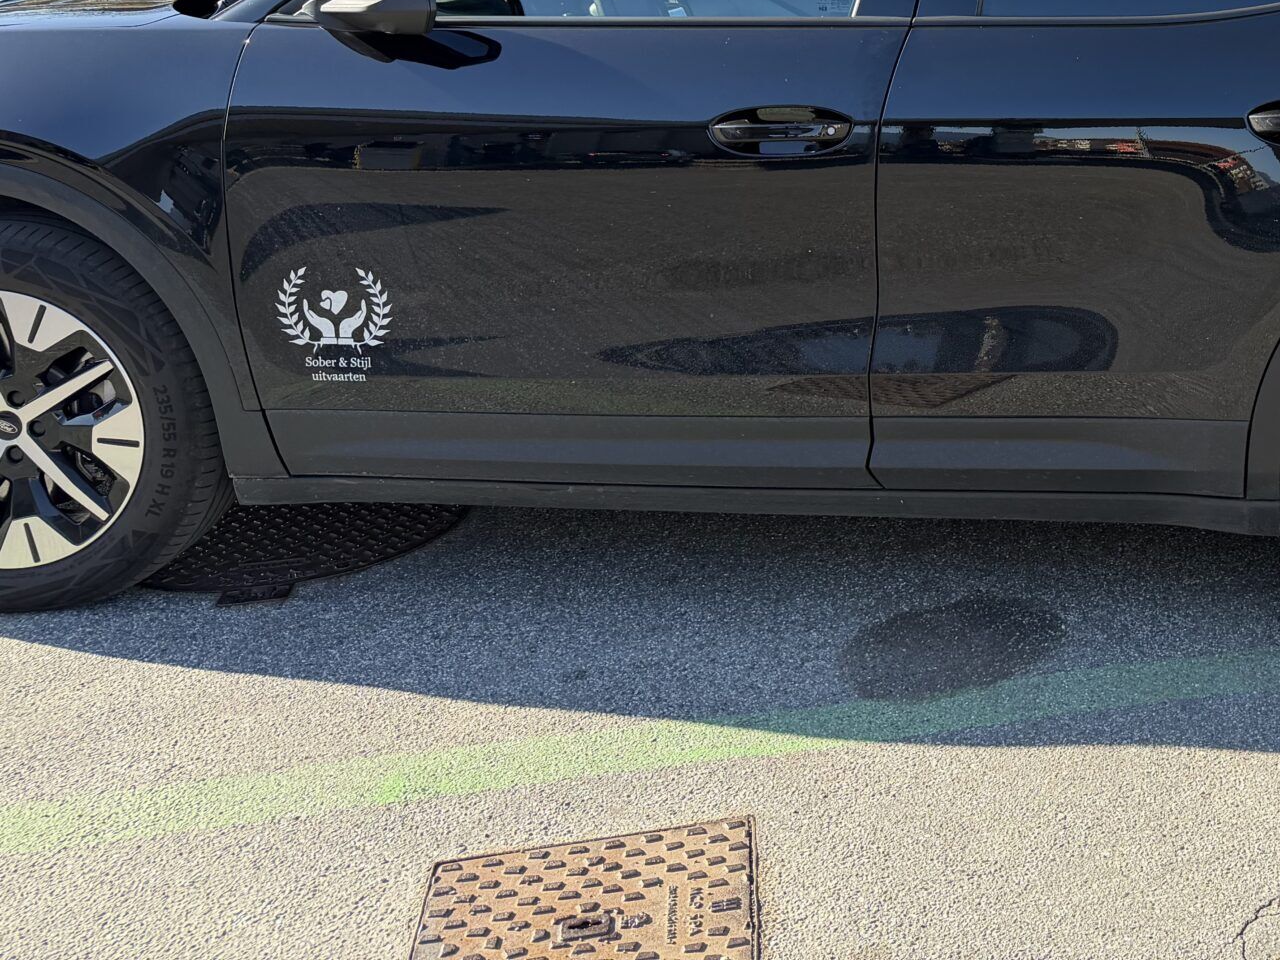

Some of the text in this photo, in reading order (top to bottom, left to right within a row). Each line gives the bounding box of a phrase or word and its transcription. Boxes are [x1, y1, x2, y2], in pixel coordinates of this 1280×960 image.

[305, 356, 372, 370] Sober & Stijl
[312, 371, 367, 382] uitvaarten
[144, 384, 177, 517] 235/55 R 19 H XL
